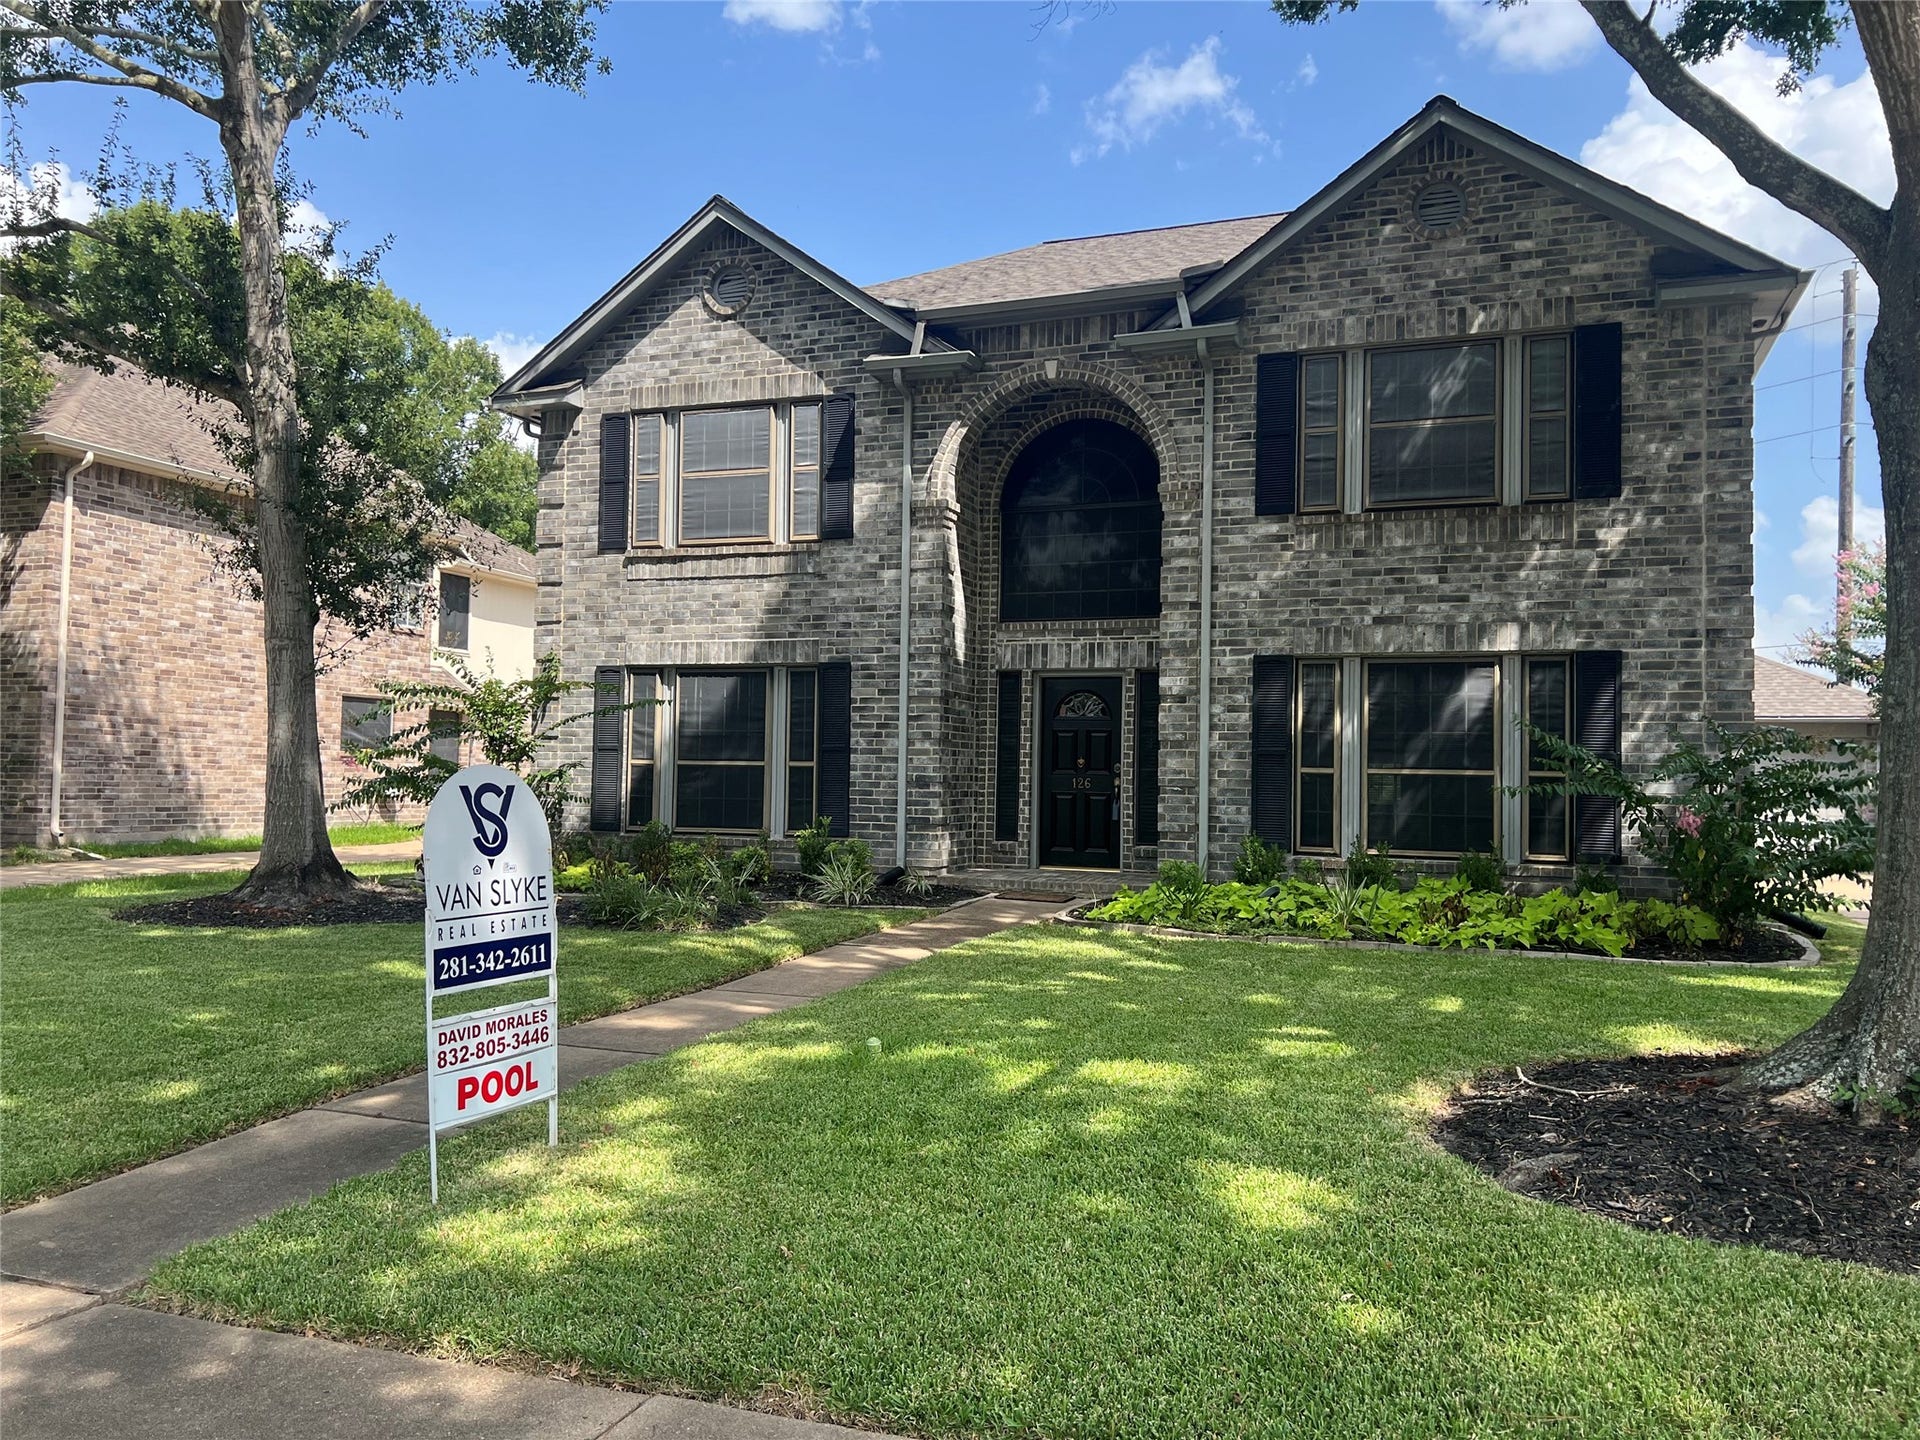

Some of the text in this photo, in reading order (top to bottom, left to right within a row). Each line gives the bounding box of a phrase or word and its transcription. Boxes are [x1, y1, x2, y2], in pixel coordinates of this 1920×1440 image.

[1072, 777, 1092, 789] 126
[436, 875, 547, 912] VAN SLYKE
[438, 914, 547, 941] REAL ESTATE
[439, 943, 547, 980] 281-342-2611
[438, 1009, 548, 1046] DAVID MORALES
[437, 1026, 549, 1069] 832-805-3446
[457, 1061, 539, 1111] POOL
